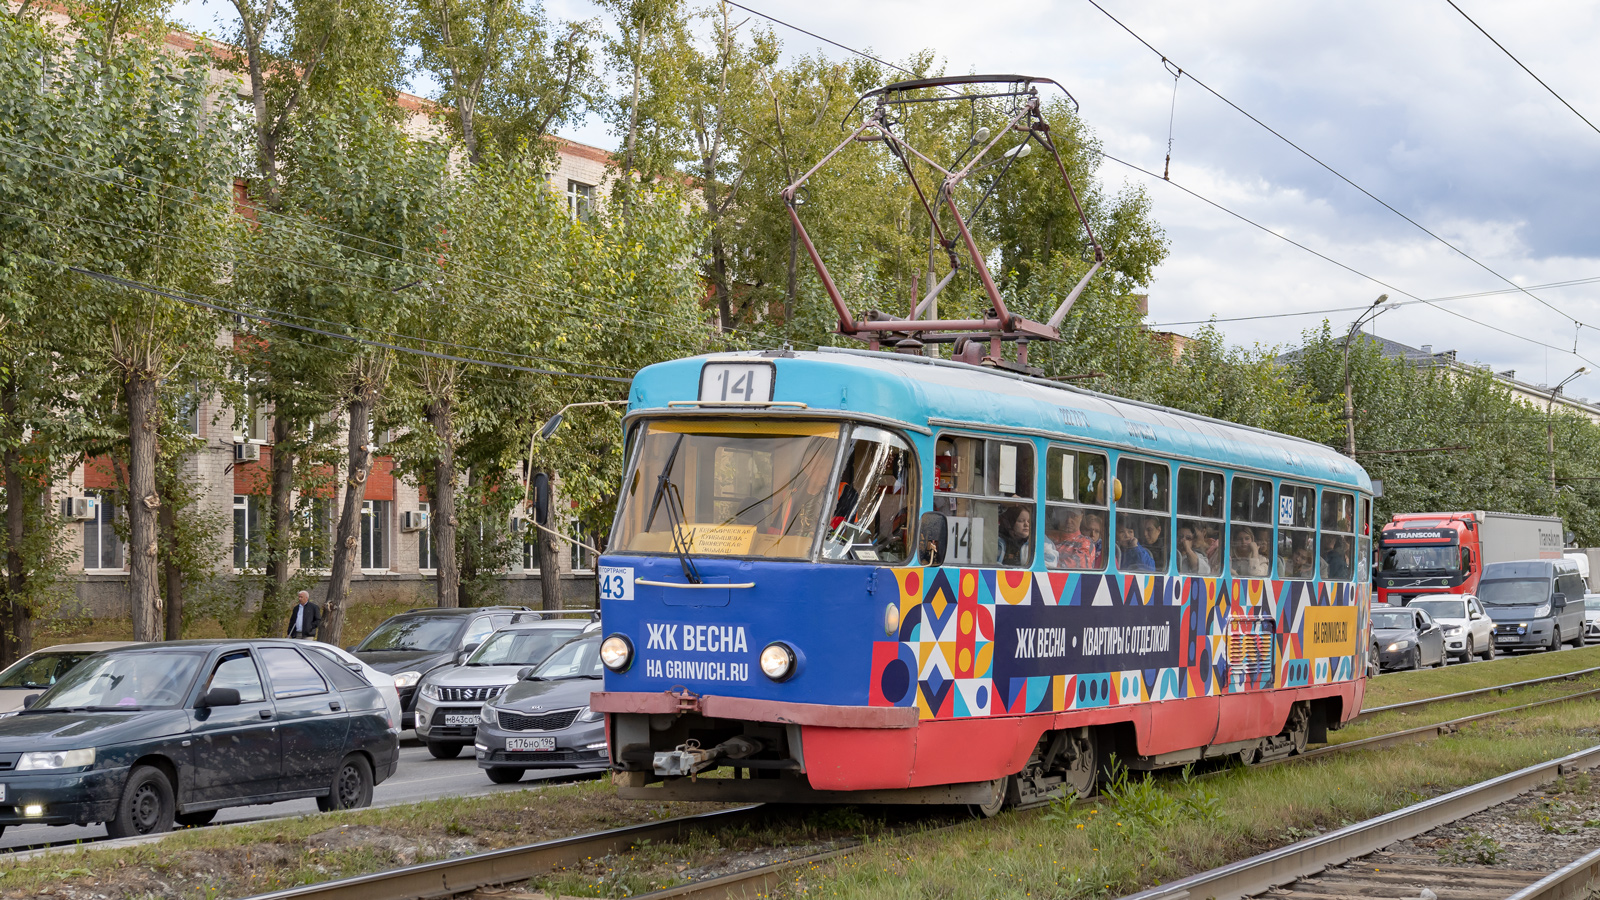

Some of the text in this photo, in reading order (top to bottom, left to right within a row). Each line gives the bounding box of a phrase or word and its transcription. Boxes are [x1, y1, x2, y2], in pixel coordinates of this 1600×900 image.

[717, 369, 754, 402] 14
[1281, 498, 1293, 518] 543
[952, 522, 971, 559] 14
[1396, 531, 1441, 539] TRANSCOM
[646, 623, 748, 653] ЖК ВЕСНА
[1014, 621, 1170, 658] ЖК ВЕСНА КВАРТИРЫ С ОТДЕЛКОЙ
[1313, 622, 1320, 643] НА
[646, 659, 749, 682] НА GRINVICH.RU
[508, 737, 554, 749] Е176НО 196
